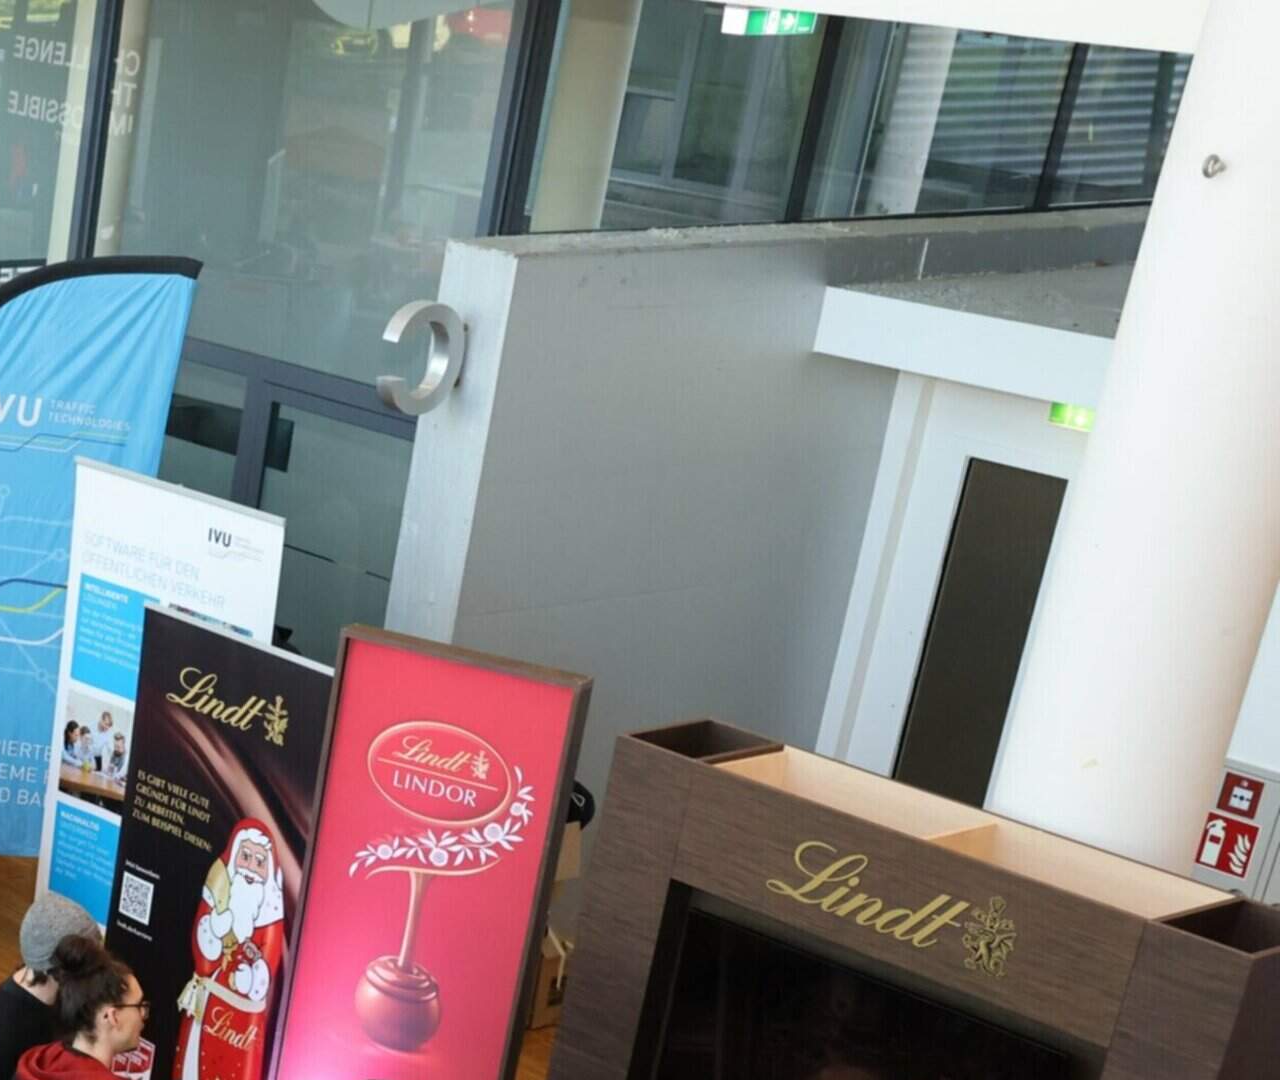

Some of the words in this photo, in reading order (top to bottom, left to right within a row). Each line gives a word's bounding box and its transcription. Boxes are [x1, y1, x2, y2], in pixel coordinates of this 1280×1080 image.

[48, 410, 132, 432] TECHNOLOGIES
[50, 399, 96, 415] TRAFFIC
[85, 531, 146, 561] SOFTWARE
[208, 527, 232, 548] IVU
[166, 667, 267, 731] Lindt
[392, 735, 472, 772] Lindt
[17, 789, 43, 808] BA
[393, 769, 477, 807] LINDOR
[766, 840, 970, 948] Lindt
[203, 1006, 258, 1051] Lindt
